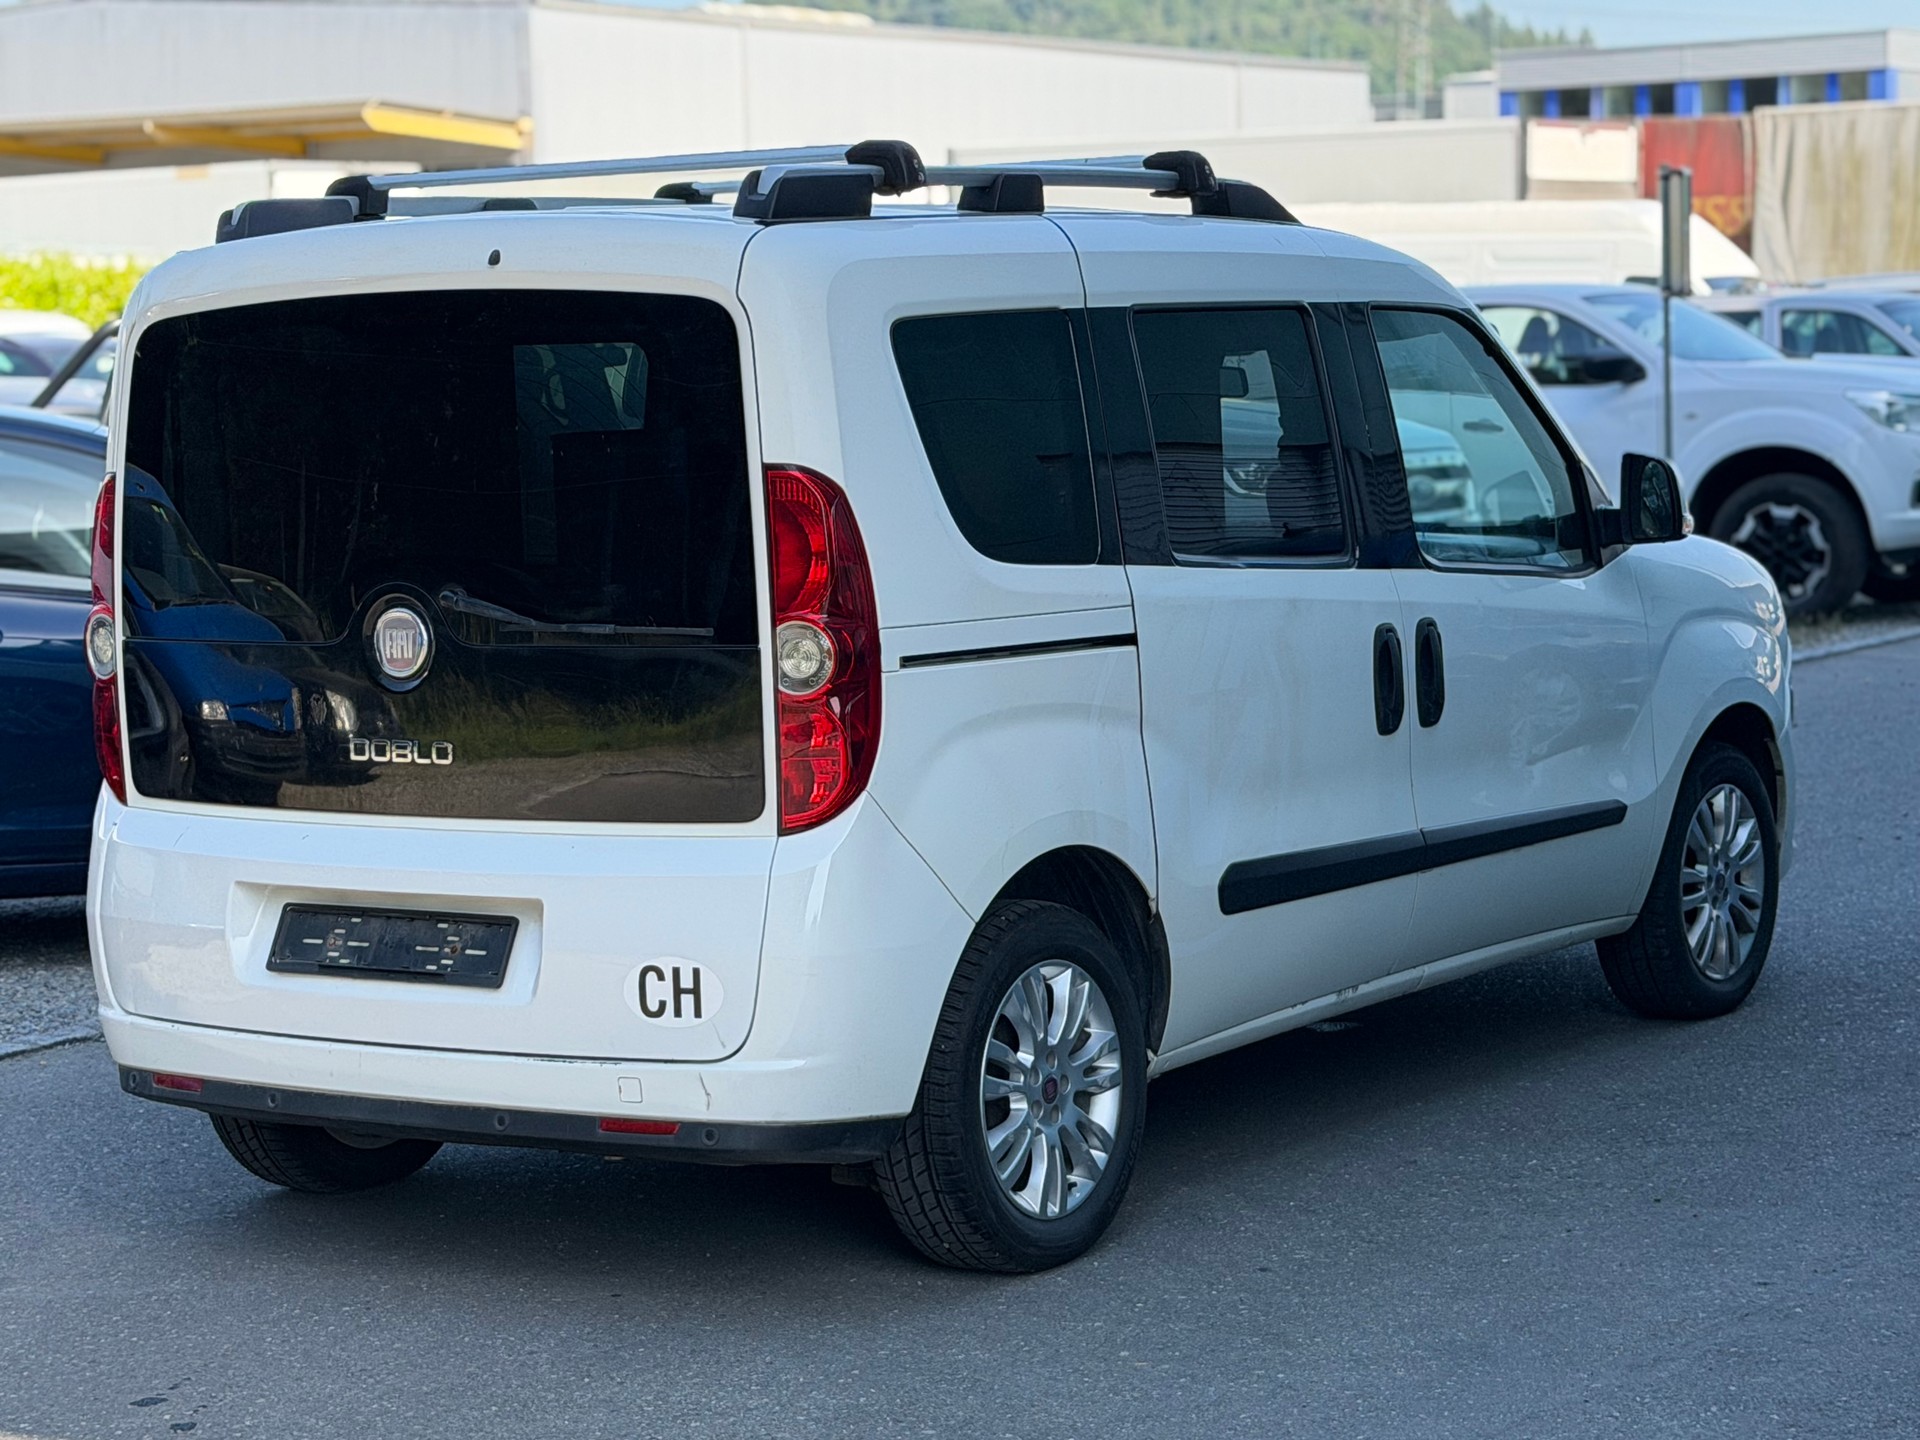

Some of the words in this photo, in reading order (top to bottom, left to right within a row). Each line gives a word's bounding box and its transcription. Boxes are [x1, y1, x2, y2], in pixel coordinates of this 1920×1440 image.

[384, 628, 416, 660] FIAT
[349, 738, 453, 765] DOBLO
[638, 964, 702, 1019] CH
